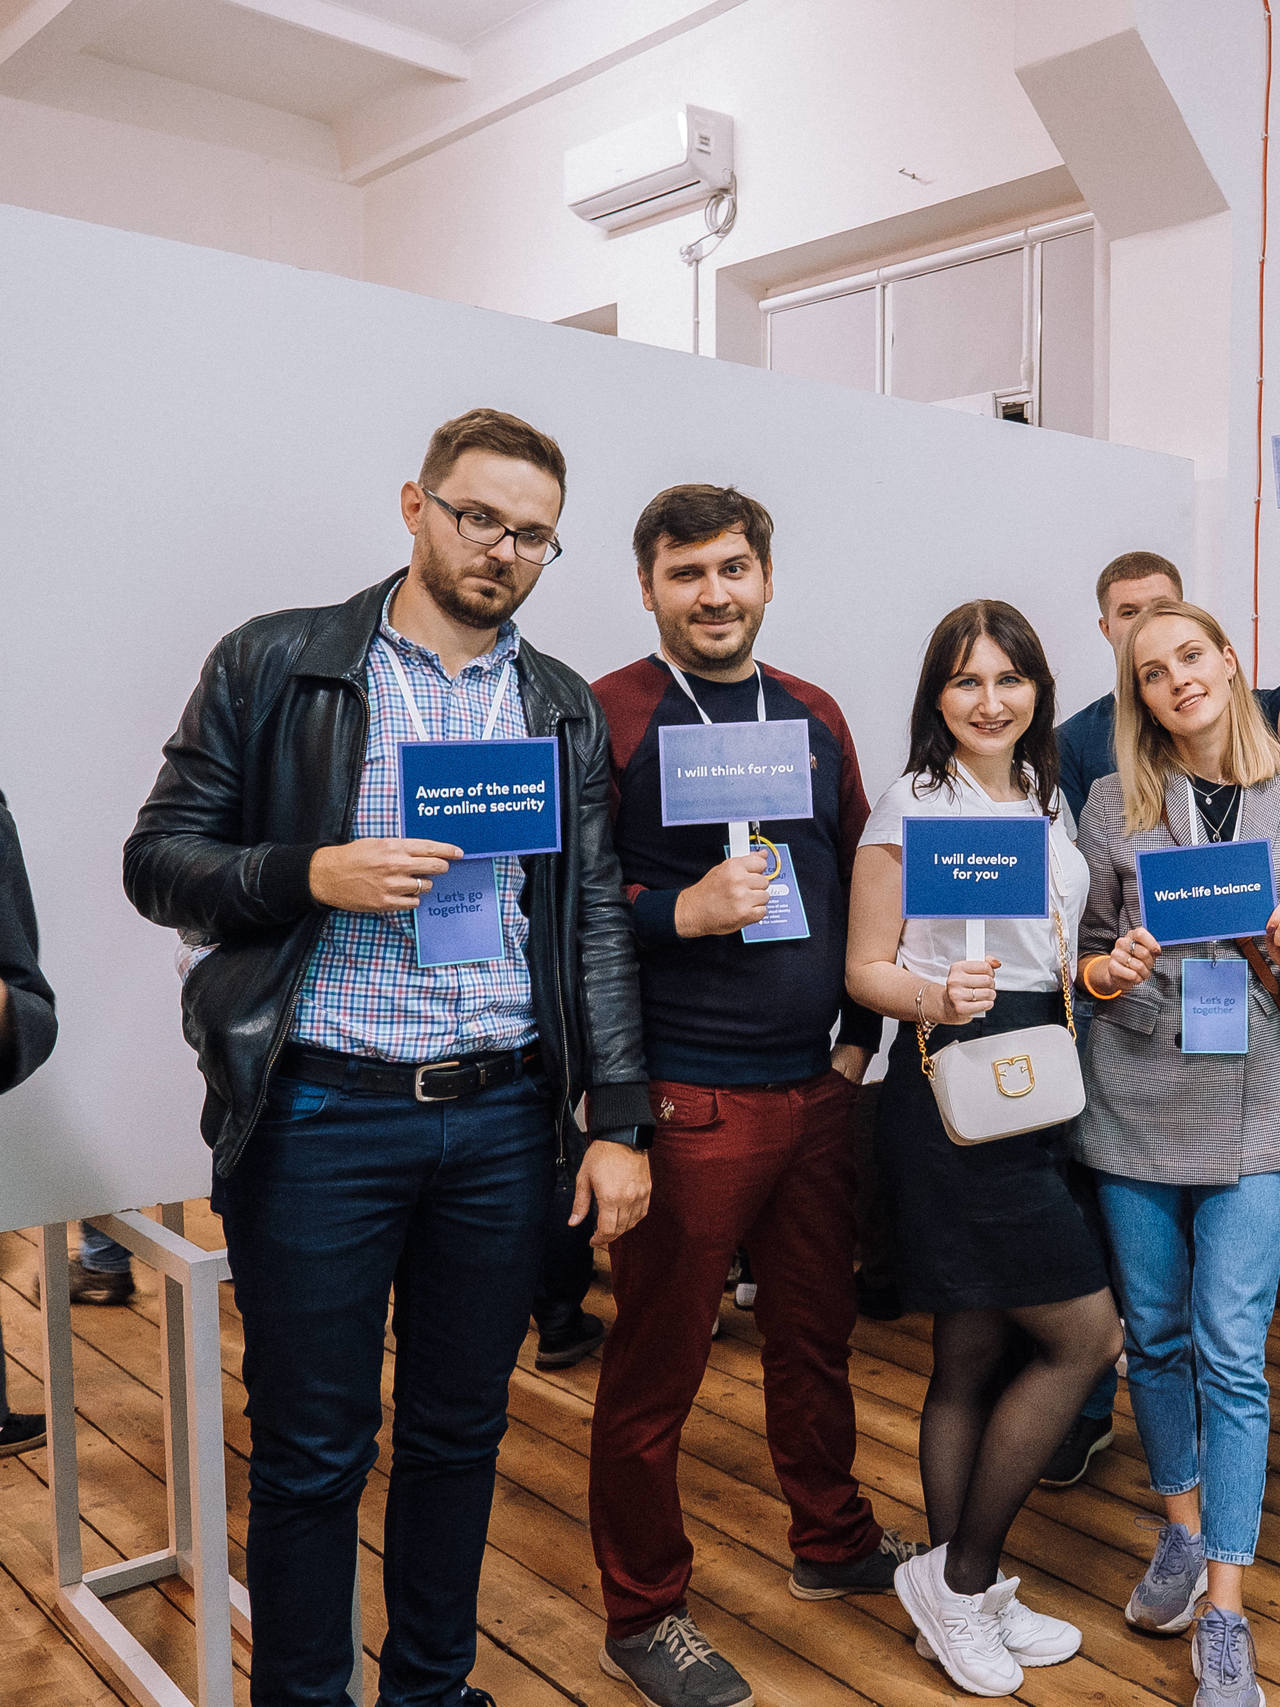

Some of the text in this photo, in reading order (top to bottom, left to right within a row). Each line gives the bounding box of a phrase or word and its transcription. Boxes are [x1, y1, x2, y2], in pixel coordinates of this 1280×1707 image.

[677, 763, 794, 778] I will think for you
[416, 780, 545, 799] Aware of the need
[417, 797, 545, 816] for online security
[934, 853, 1018, 867] I will develop
[952, 868, 999, 882] for you
[437, 891, 483, 903] Let's go
[1154, 881, 1261, 902] Work-life balance
[428, 903, 483, 918] together.
[1200, 996, 1236, 1006] Let's go
